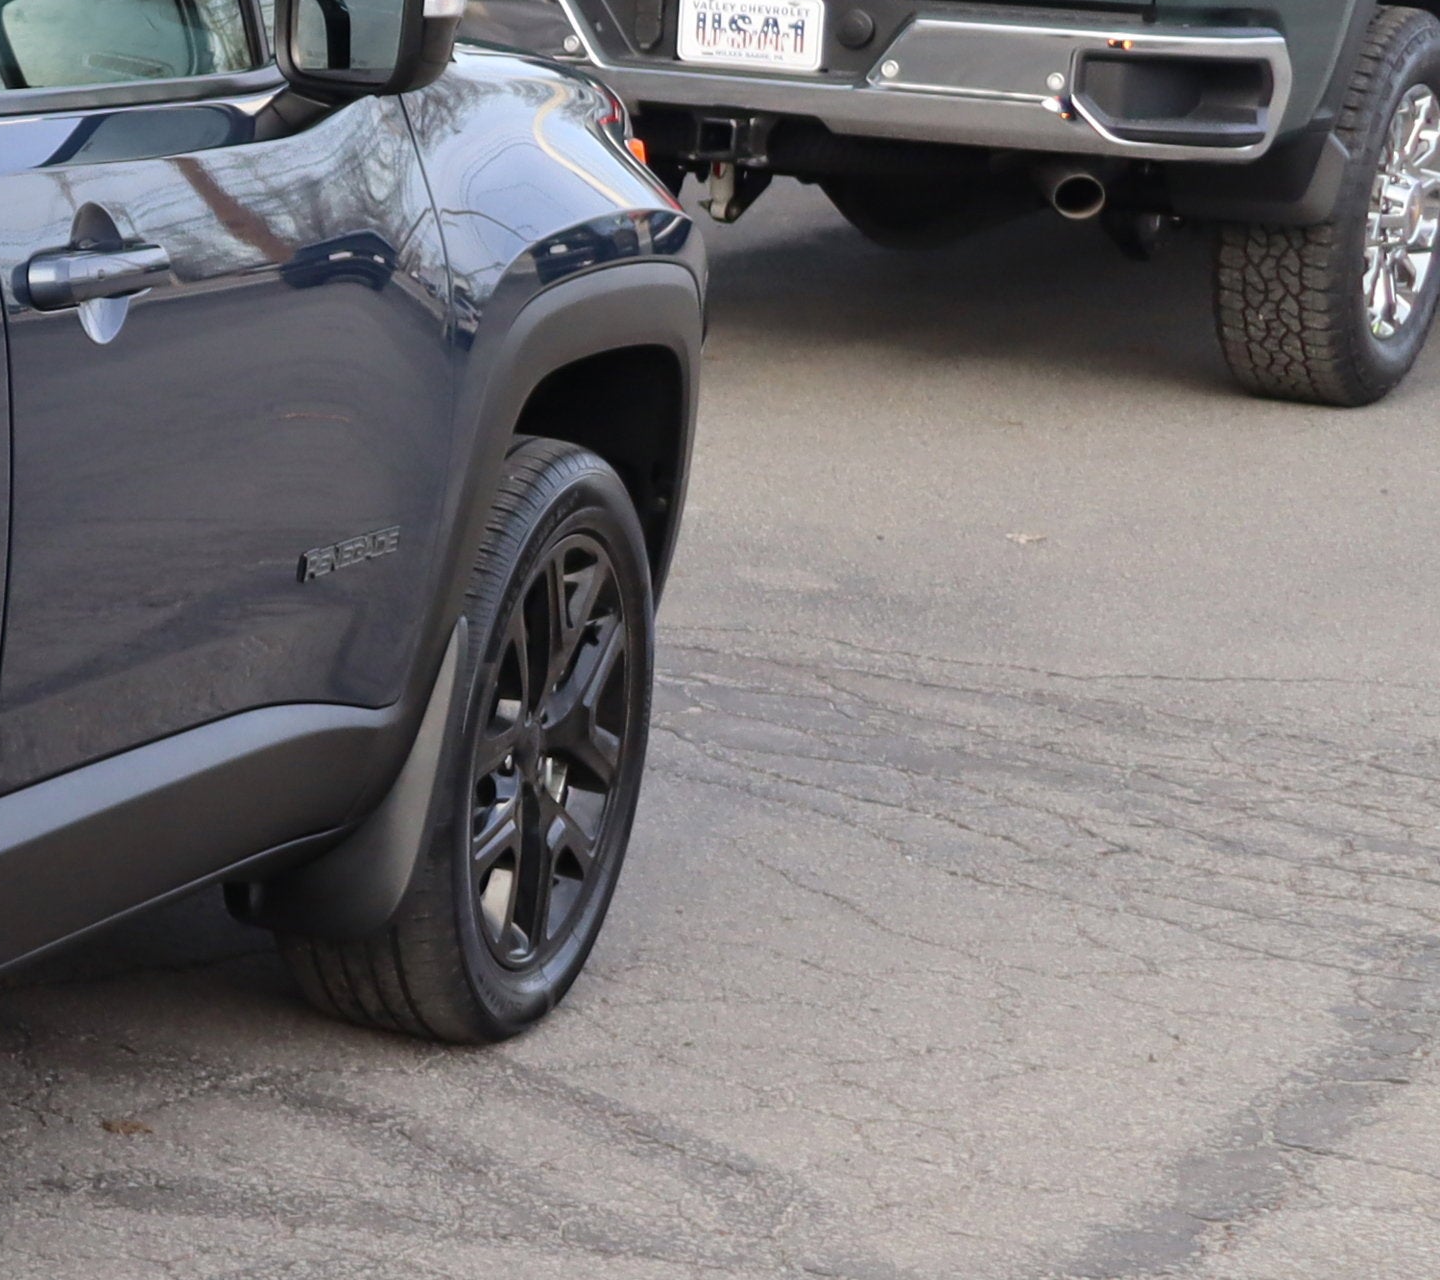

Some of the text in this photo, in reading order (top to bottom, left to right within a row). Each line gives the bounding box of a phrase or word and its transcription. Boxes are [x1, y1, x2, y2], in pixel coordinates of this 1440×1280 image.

[692, 0, 811, 18] VALLEY CHEVROLET
[296, 525, 401, 584] RENEGADE
